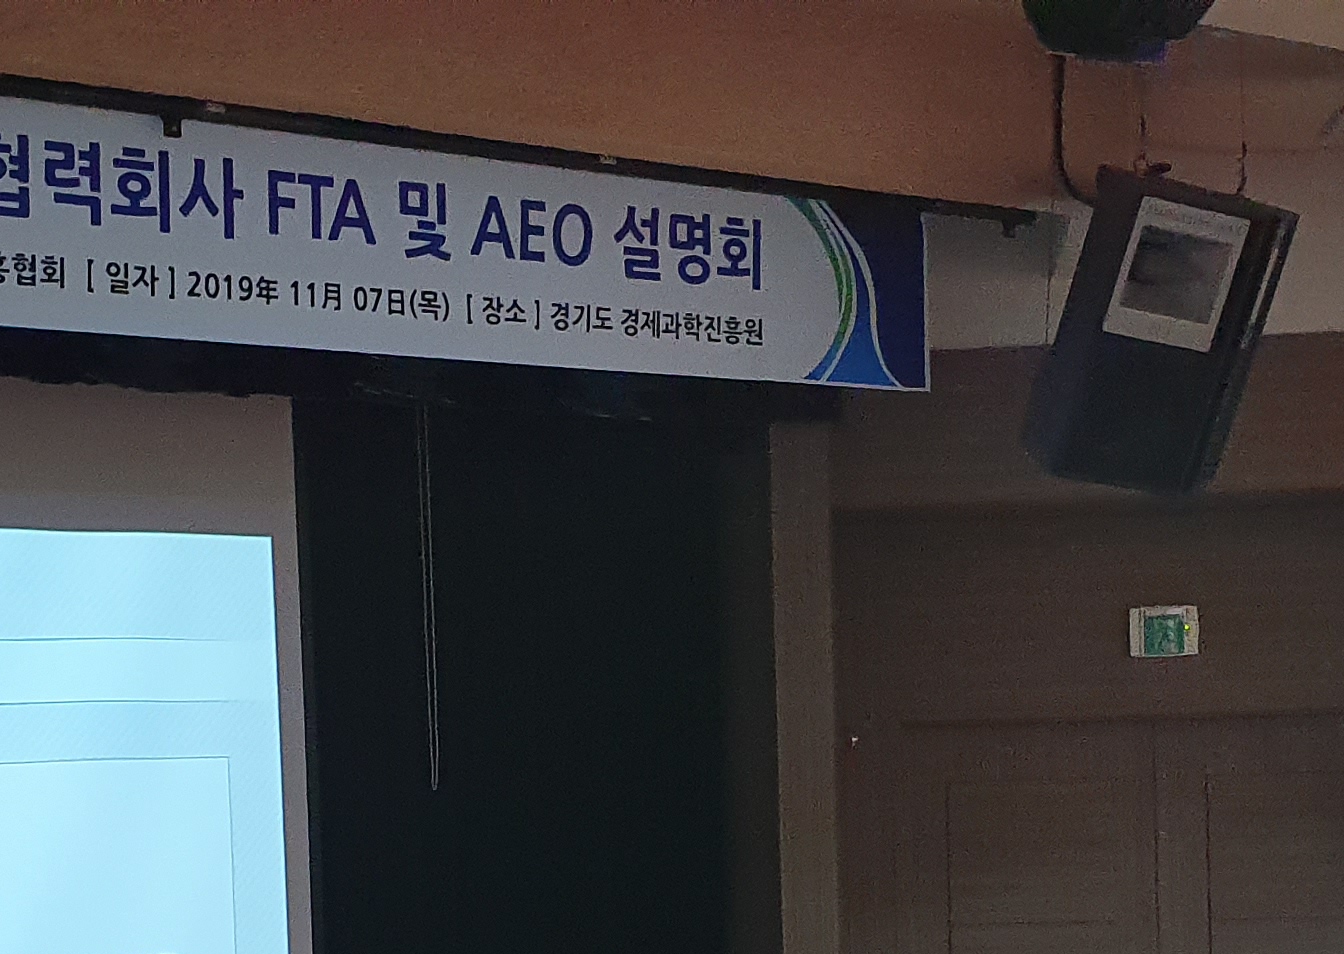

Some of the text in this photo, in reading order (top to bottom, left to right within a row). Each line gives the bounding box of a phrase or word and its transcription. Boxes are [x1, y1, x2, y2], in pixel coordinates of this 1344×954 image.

[267, 169, 376, 246] FTA
[399, 180, 452, 262] 및
[471, 196, 593, 268] AEO
[613, 203, 763, 291] 설명회
[549, 301, 613, 335] 경기도
[620, 306, 765, 347] 경제과학진흥원
